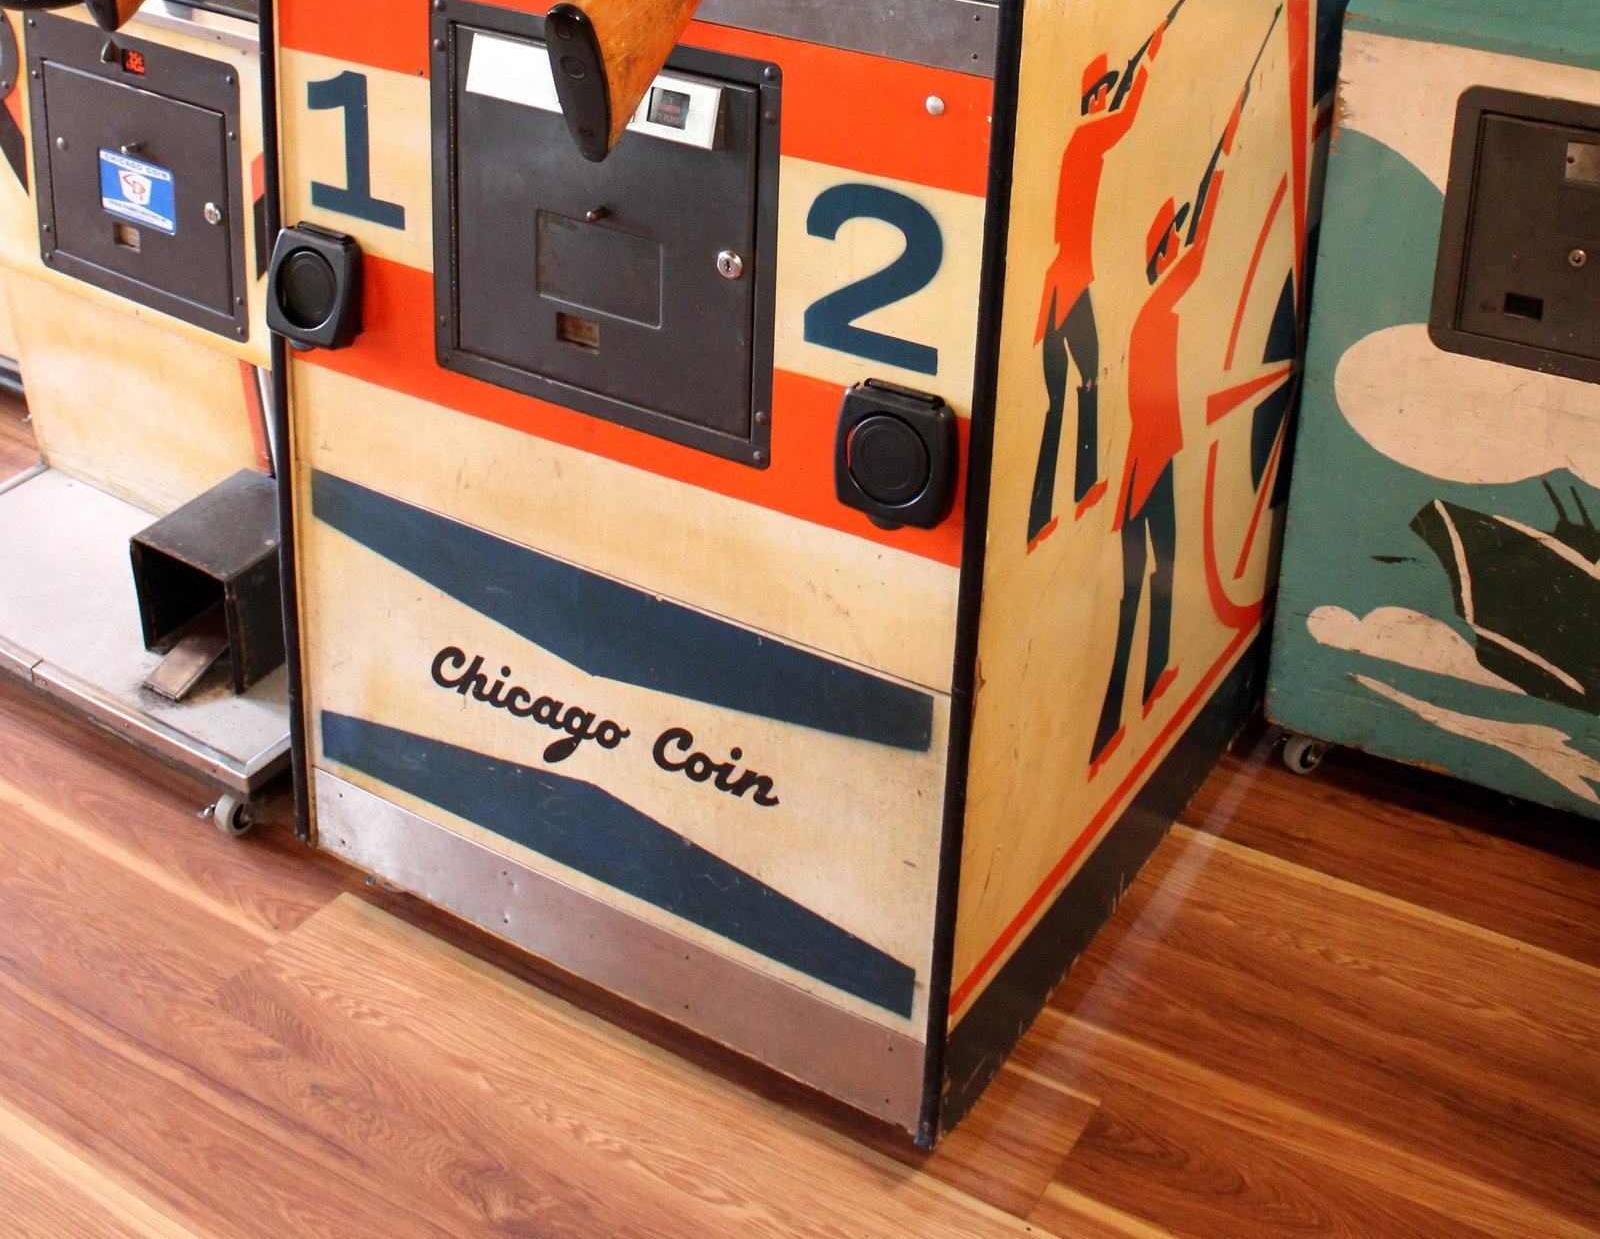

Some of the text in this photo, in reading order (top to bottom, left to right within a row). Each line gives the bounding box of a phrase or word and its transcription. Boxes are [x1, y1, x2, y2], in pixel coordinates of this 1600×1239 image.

[104, 153, 169, 180] CHICAGO COIN
[307, 69, 405, 231] 1
[804, 183, 944, 376] 2
[431, 646, 780, 806] Chicago Coin
